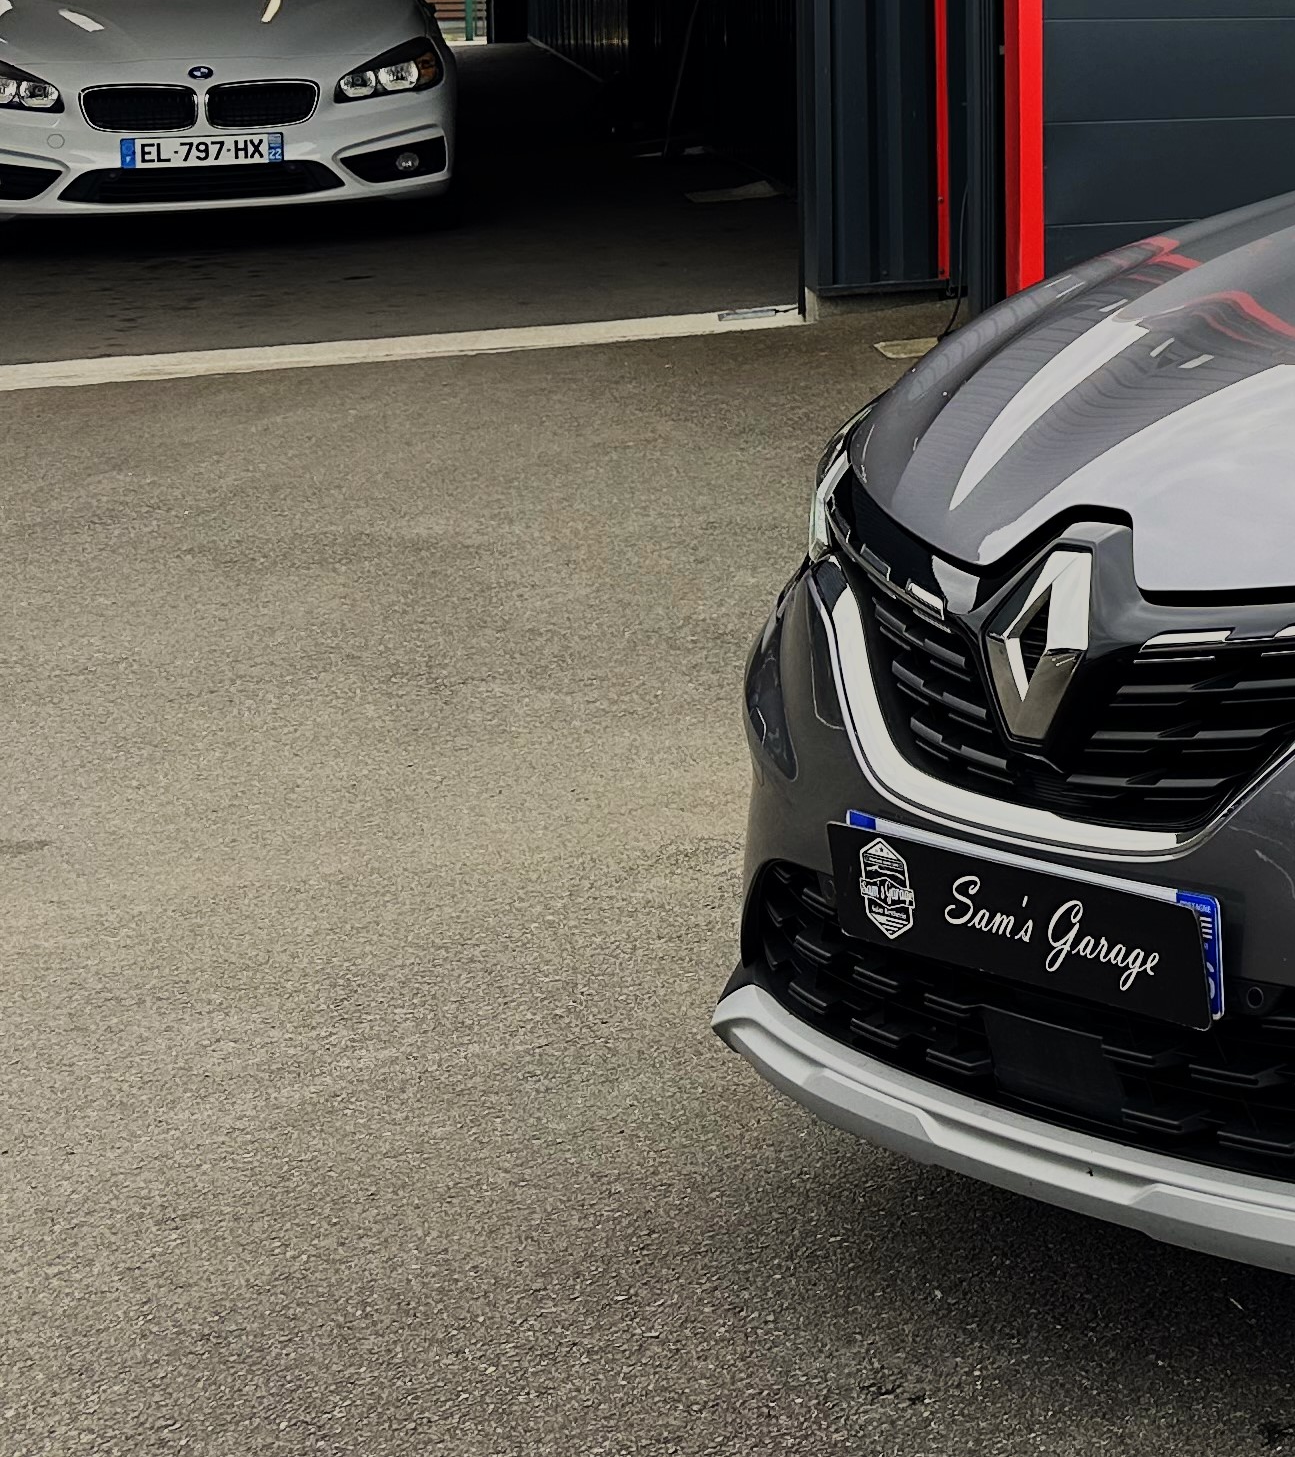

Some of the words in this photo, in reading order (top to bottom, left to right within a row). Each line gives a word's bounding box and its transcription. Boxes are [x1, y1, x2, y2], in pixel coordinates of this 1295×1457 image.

[140, 139, 264, 163] EL-797-HX
[944, 875, 1033, 943] Sam's
[1045, 900, 1160, 991] Garage
